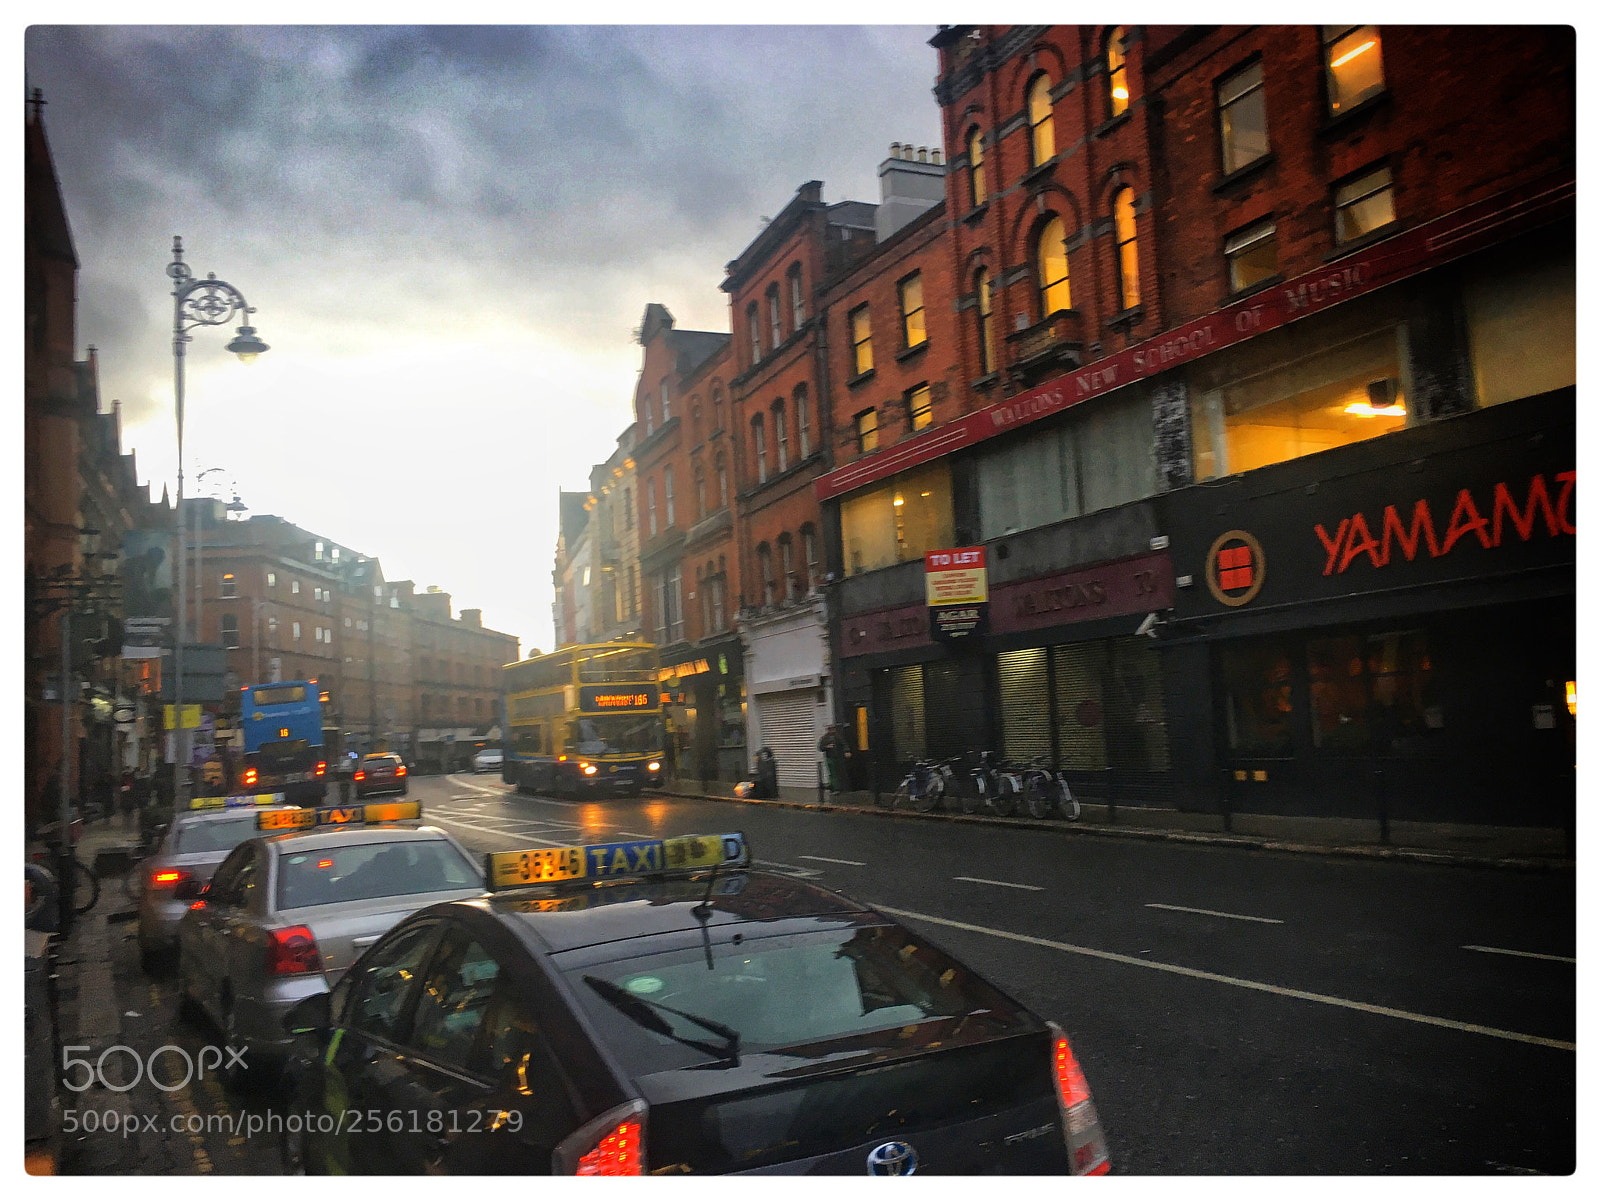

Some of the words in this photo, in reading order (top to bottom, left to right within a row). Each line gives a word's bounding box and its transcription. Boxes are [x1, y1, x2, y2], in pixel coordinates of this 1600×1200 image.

[1076, 364, 1119, 396] NEW
[1133, 326, 1217, 373] SCHOOL
[1235, 304, 1265, 331] OF
[1284, 262, 1371, 314] MUSIC
[929, 554, 951, 566] TO
[952, 551, 981, 564] LET
[592, 844, 663, 876] TAXI
